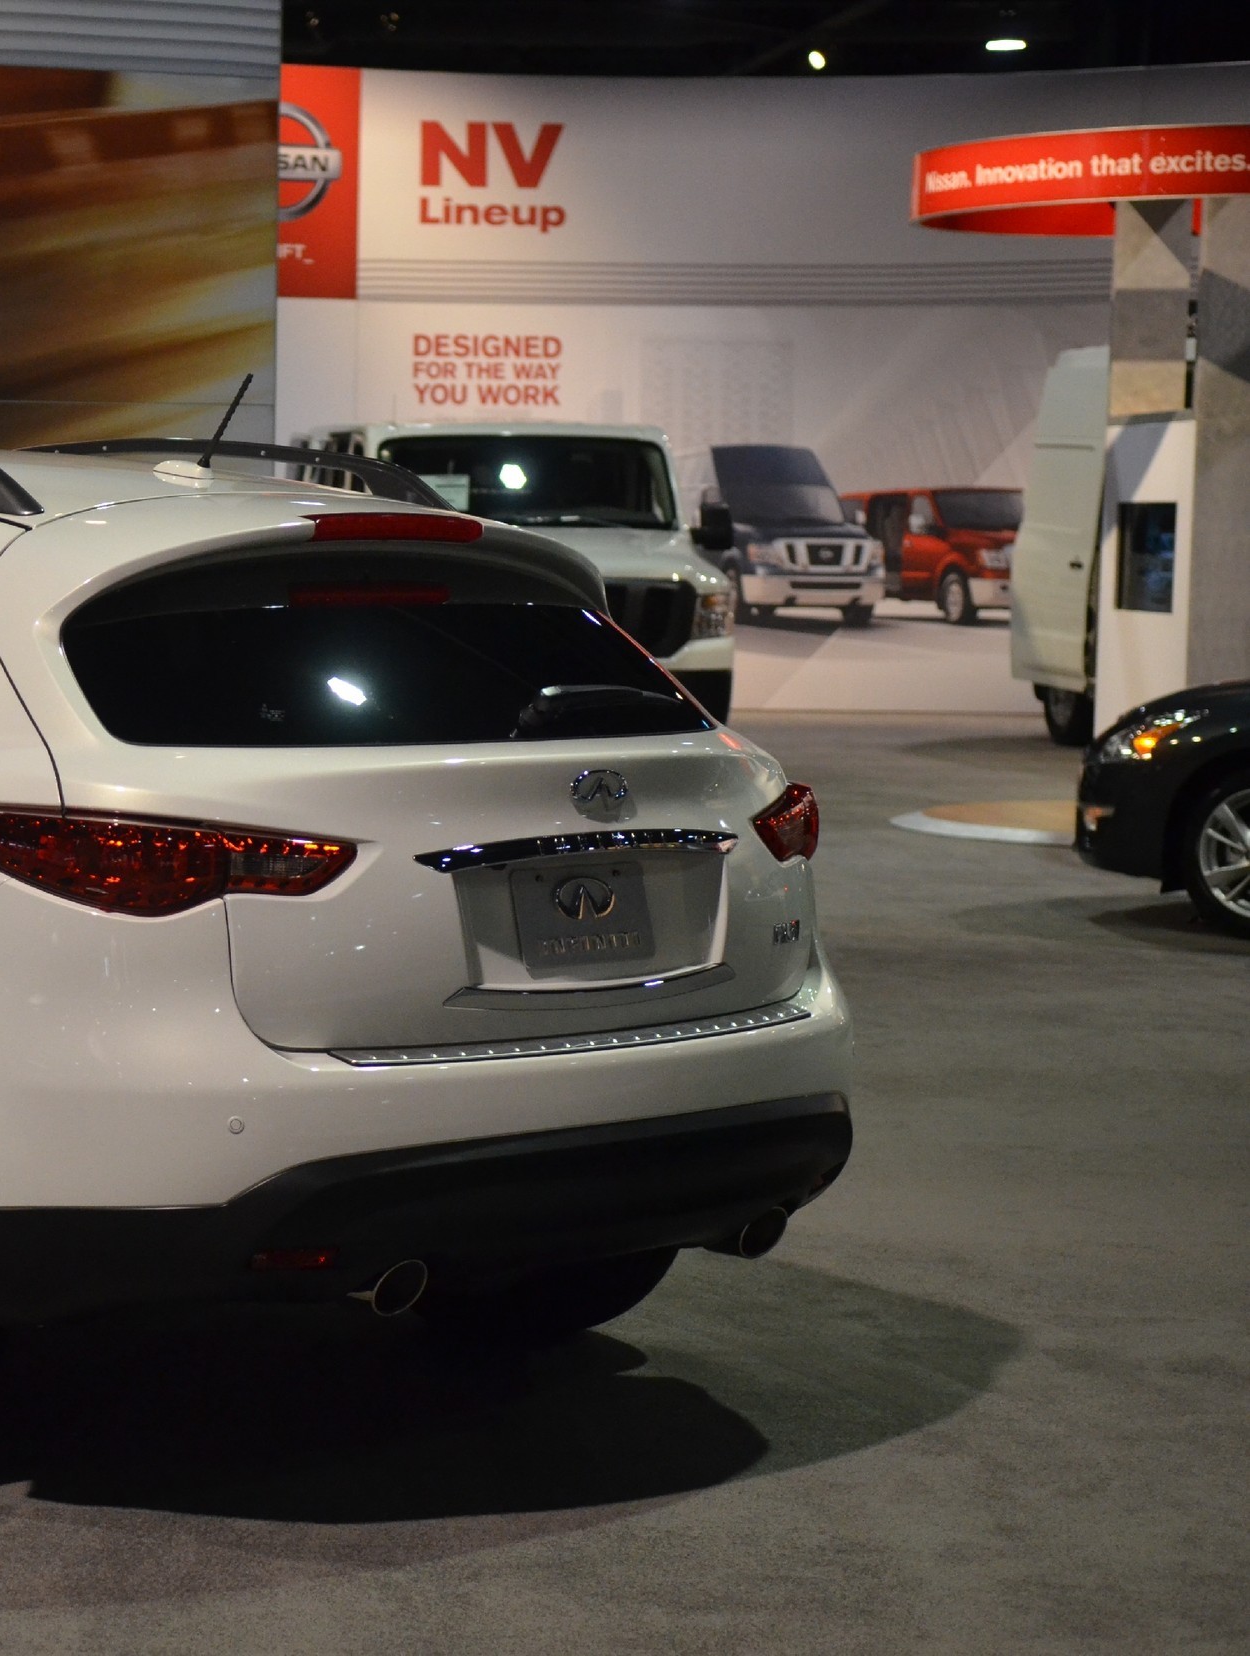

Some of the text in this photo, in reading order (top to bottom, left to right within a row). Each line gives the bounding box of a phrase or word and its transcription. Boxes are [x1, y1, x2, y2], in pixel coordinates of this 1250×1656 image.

[420, 119, 564, 188] NV
[924, 149, 1250, 193] Nissan. Innovation that excites.
[419, 196, 566, 233] Lineup
[412, 333, 563, 358] DESIGNED
[412, 361, 560, 380] FOR THE WAY
[413, 382, 561, 406] YOU WORK
